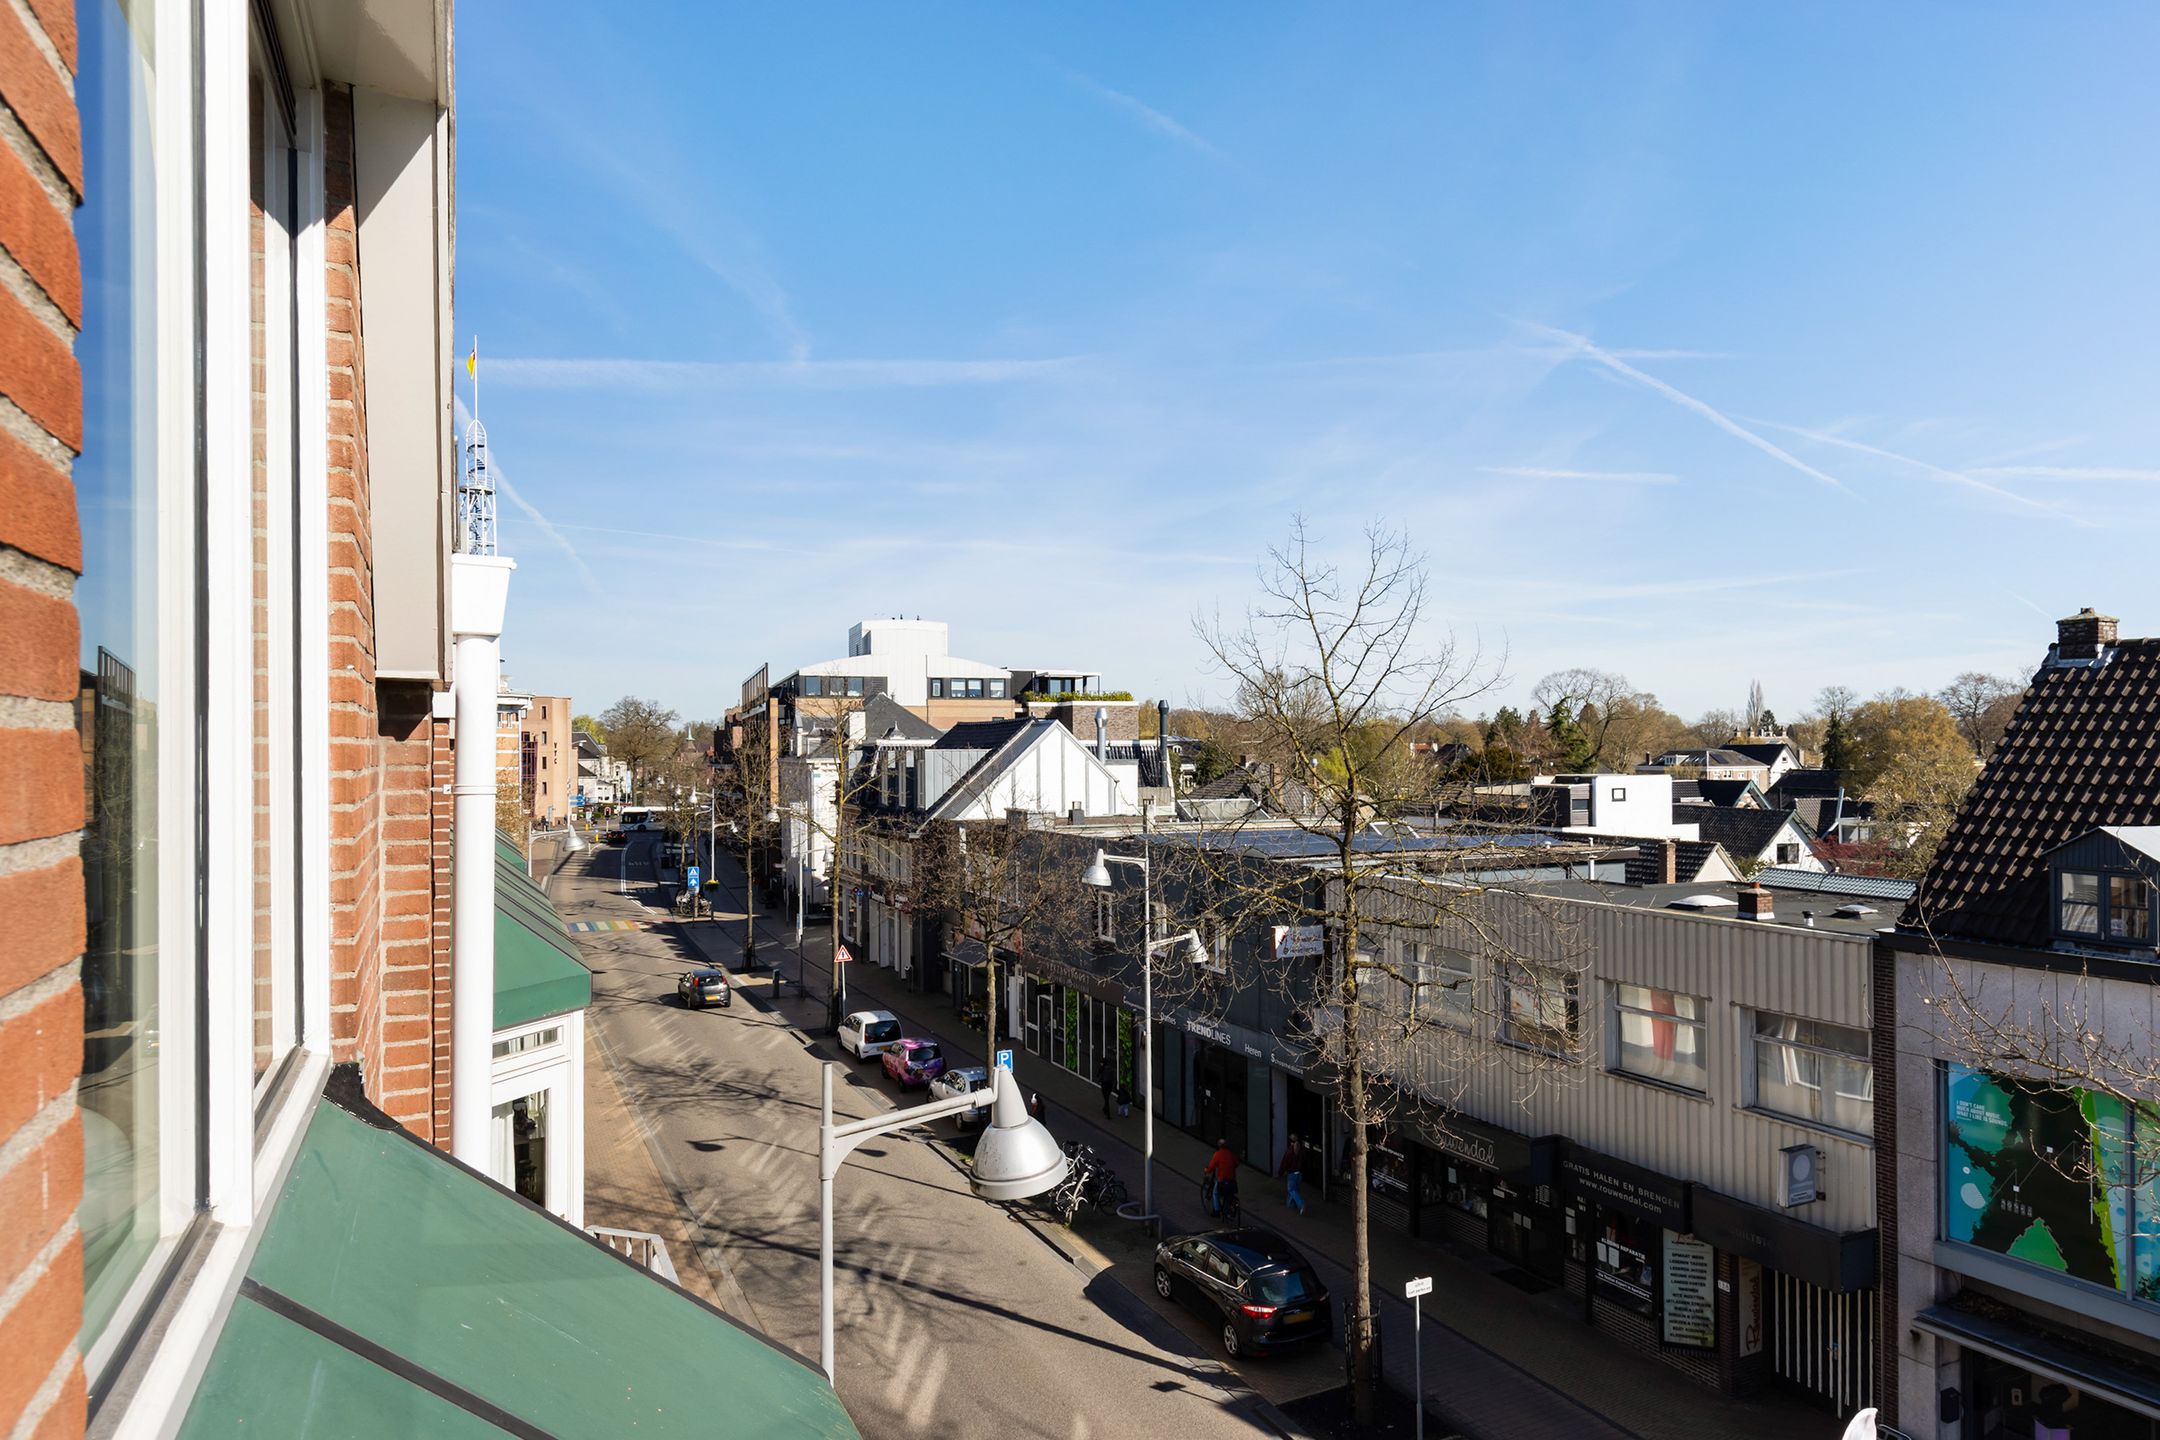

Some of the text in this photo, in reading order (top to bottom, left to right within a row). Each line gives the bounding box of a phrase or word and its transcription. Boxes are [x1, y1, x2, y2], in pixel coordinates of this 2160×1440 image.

[1186, 1020, 1231, 1046] TRENDLINES
[1000, 1052, 1009, 1065] P
[1244, 1043, 1262, 1058] Heren
[1563, 1160, 1680, 1208] GRATIS HALEN EN BRENGEN
[1578, 1178, 1662, 1214] www.rouwendal.com
